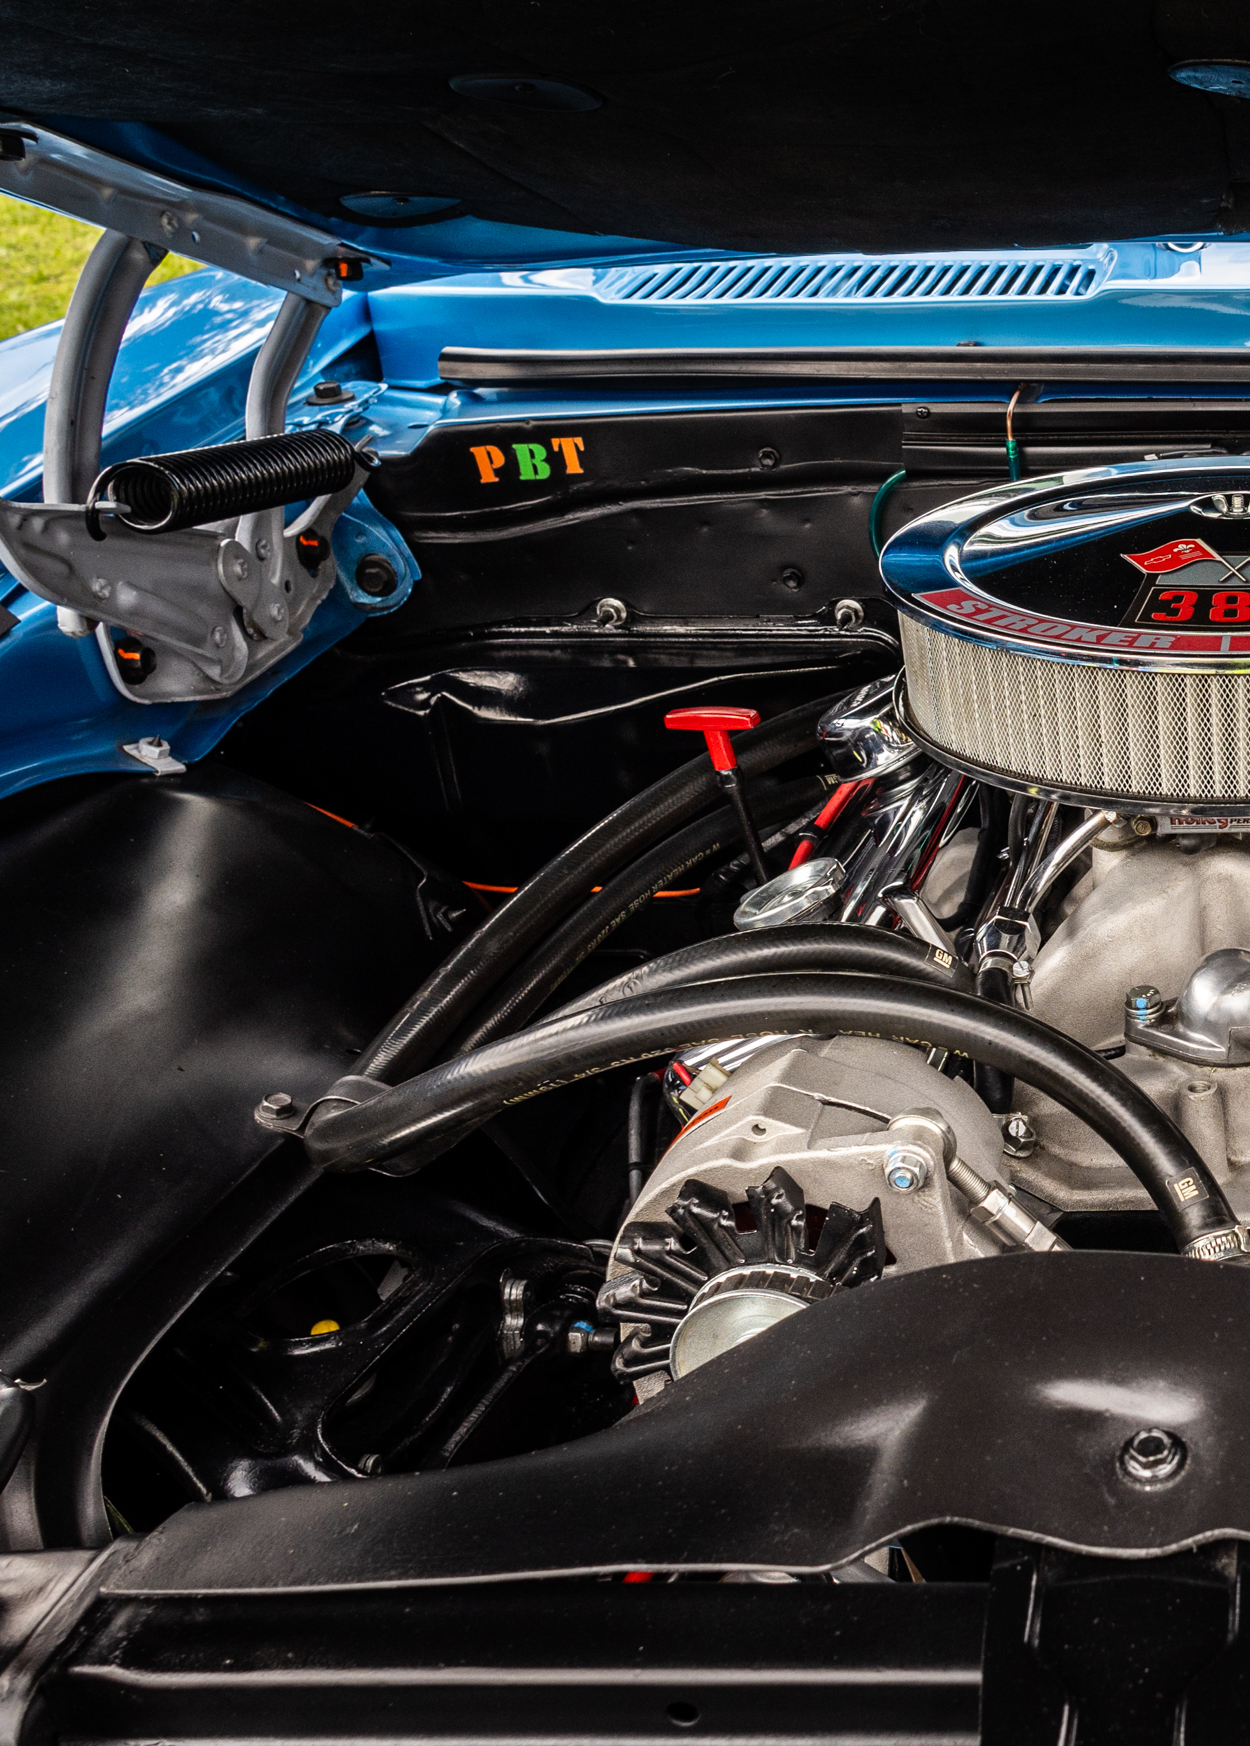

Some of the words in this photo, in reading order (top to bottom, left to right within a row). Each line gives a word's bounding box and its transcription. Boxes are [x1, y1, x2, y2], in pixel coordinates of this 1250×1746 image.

[947, 599, 1176, 649] STROKER
[685, 852, 704, 867] CAR
[651, 864, 685, 892] HEATER
[628, 889, 651, 911] HOSE
[934, 948, 953, 965] GM
[1178, 1177, 1199, 1200] GM
